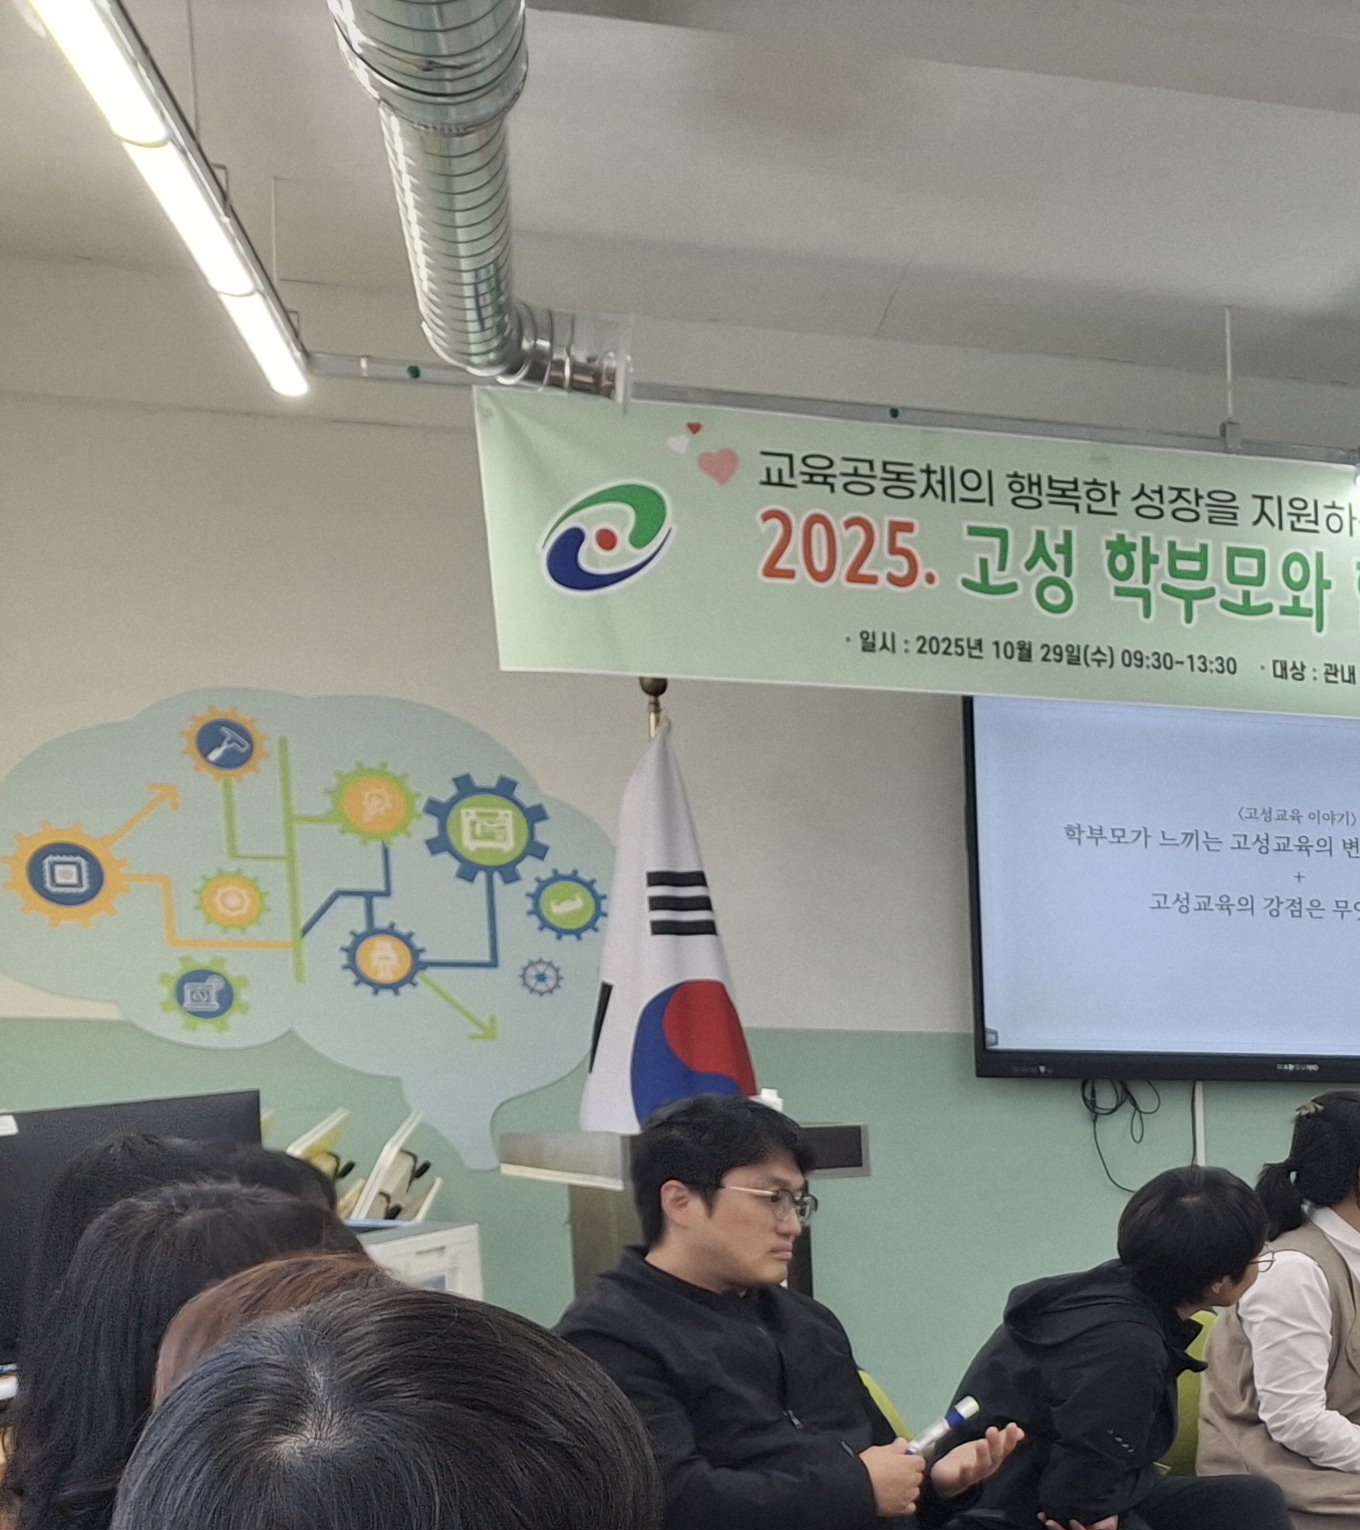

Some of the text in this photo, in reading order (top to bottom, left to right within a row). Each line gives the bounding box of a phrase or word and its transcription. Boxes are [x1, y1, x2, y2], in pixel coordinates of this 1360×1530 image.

[758, 450, 994, 507] 교육공동체의
[1005, 470, 1121, 517] 행복한
[1131, 483, 1240, 527] 성장을
[759, 507, 937, 588] 2025.
[960, 524, 1075, 615] 고성
[1104, 532, 1333, 634] 학부모와
[915, 634, 984, 660] 2025년
[992, 639, 1033, 663] 10월
[1040, 643, 1115, 669] 29일(수)
[1121, 648, 1238, 675] 09:30~13:30
[1323, 662, 1357, 685] 관내
[1063, 822, 1152, 849] 학부모가
[1158, 828, 1223, 852] 느끼는
[1229, 831, 1333, 858] 고성교육의
[1149, 891, 1255, 917] 고성교육의
[1263, 895, 1326, 919] 강점은
